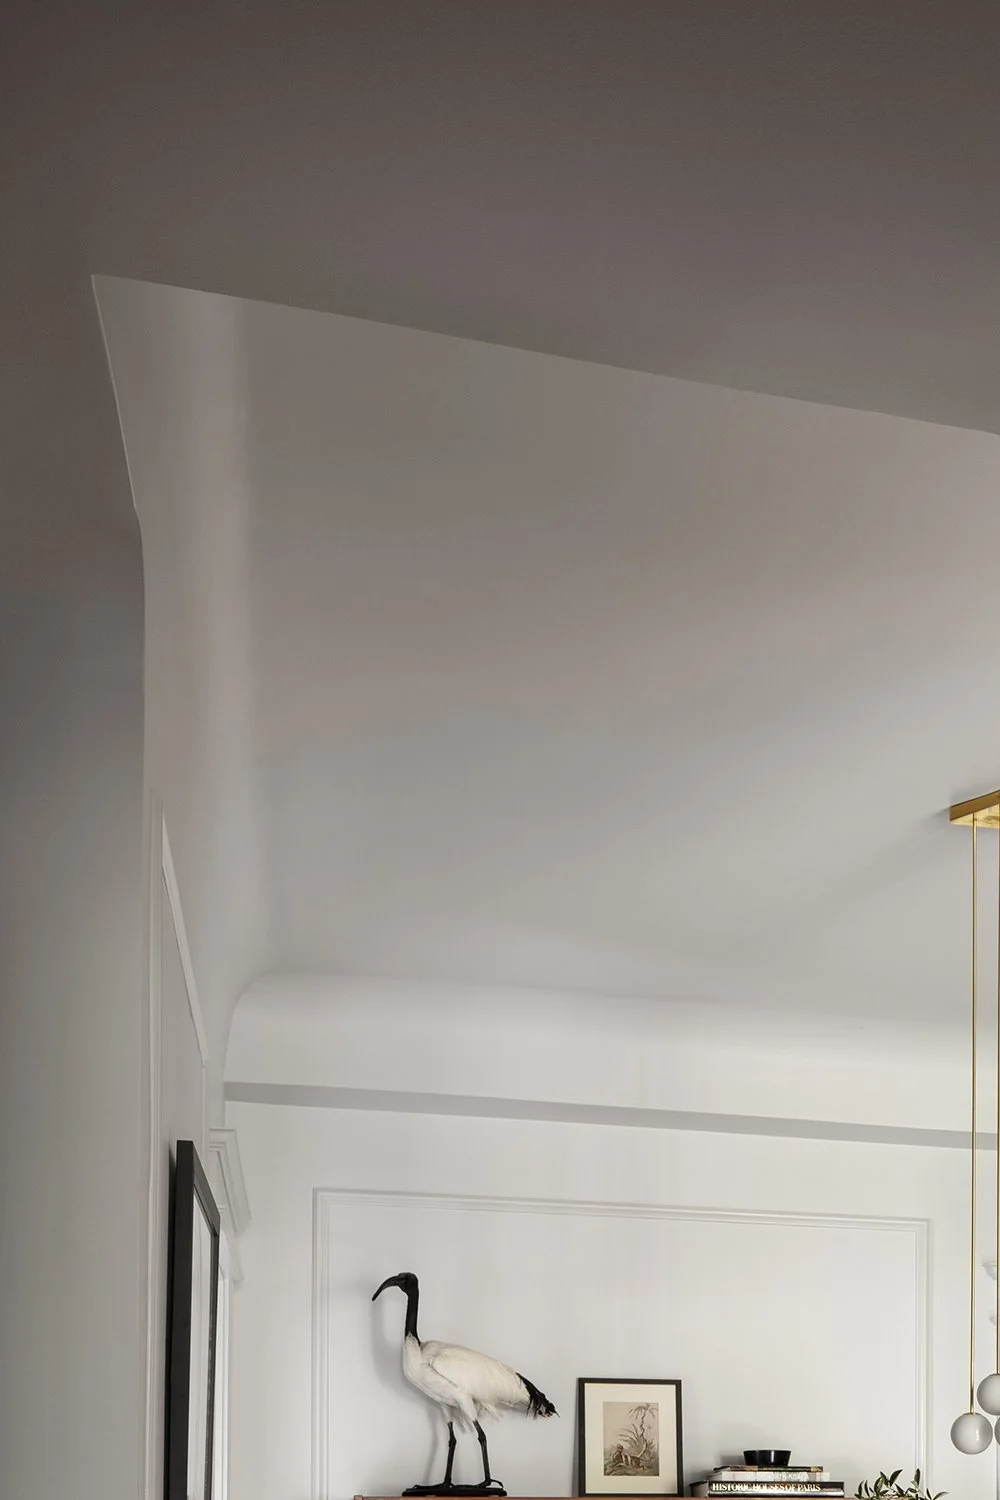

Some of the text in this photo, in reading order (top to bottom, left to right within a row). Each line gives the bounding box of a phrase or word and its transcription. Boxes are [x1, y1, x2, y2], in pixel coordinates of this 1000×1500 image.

[712, 1483, 821, 1492] HISTORIC HOUSES OF PARIS
